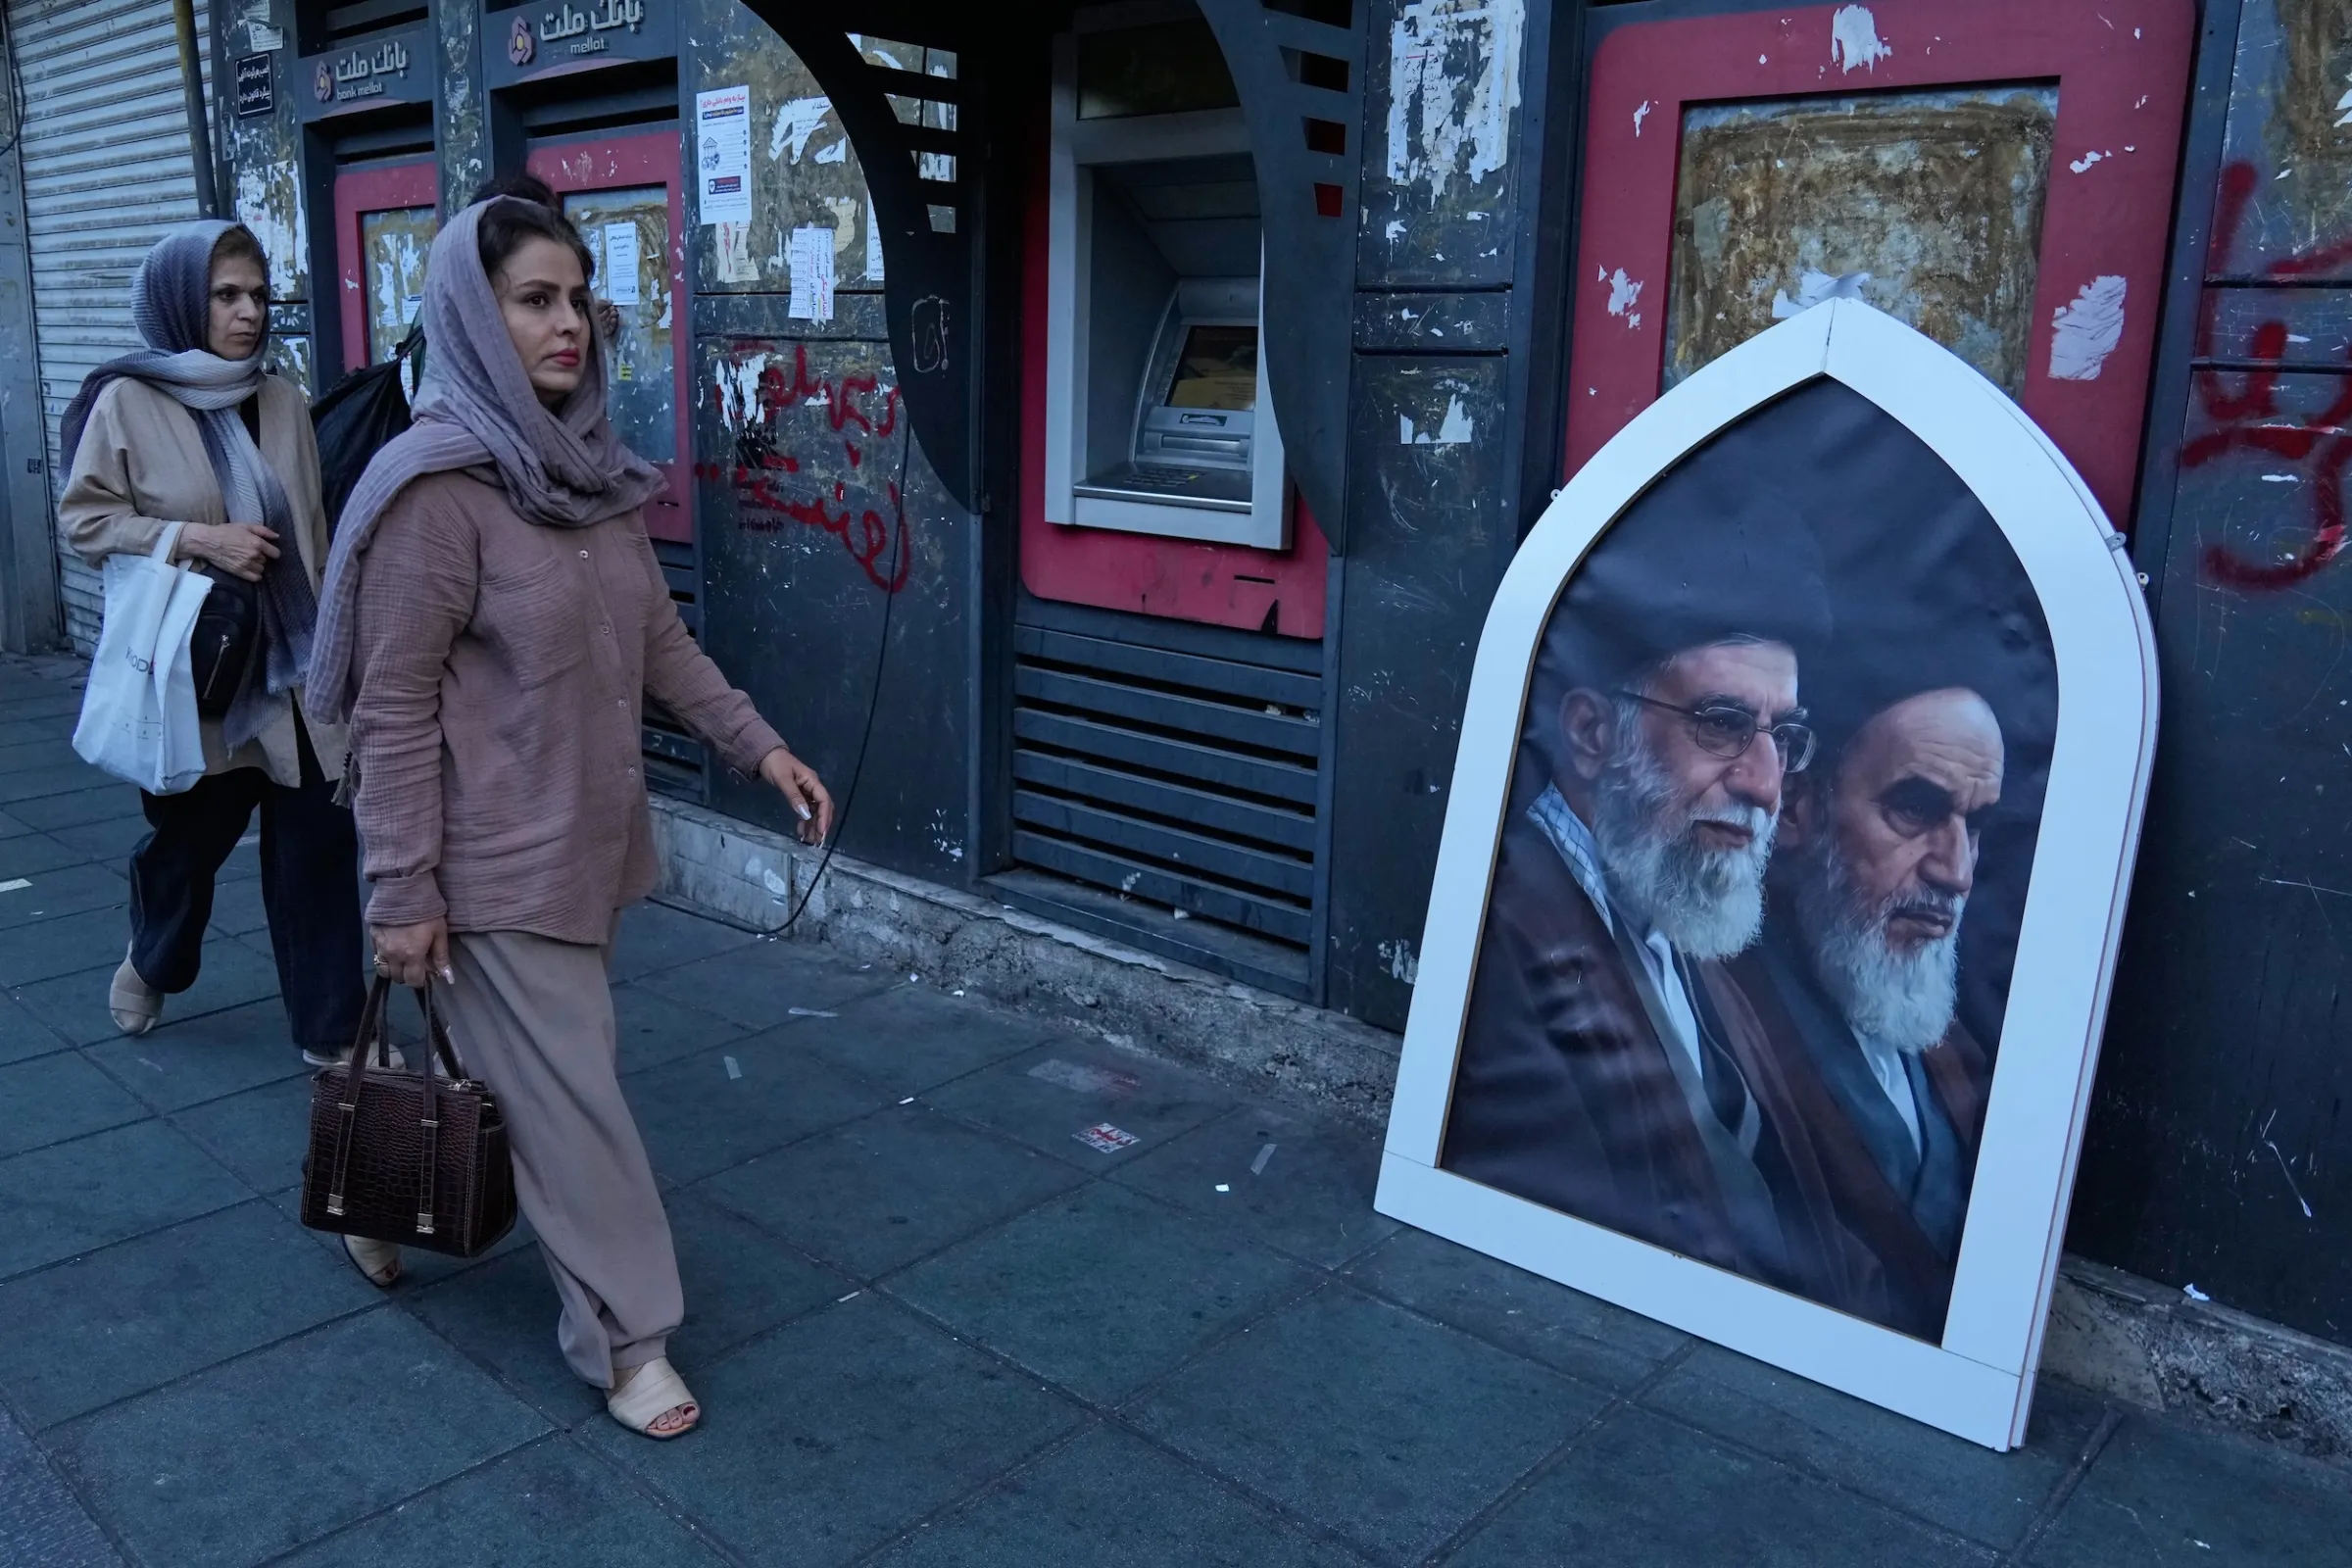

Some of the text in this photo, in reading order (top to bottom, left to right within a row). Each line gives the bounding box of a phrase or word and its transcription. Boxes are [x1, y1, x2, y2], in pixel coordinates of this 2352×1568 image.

[540, 3, 586, 41] ملت
[336, 41, 407, 81] بانک ملت
